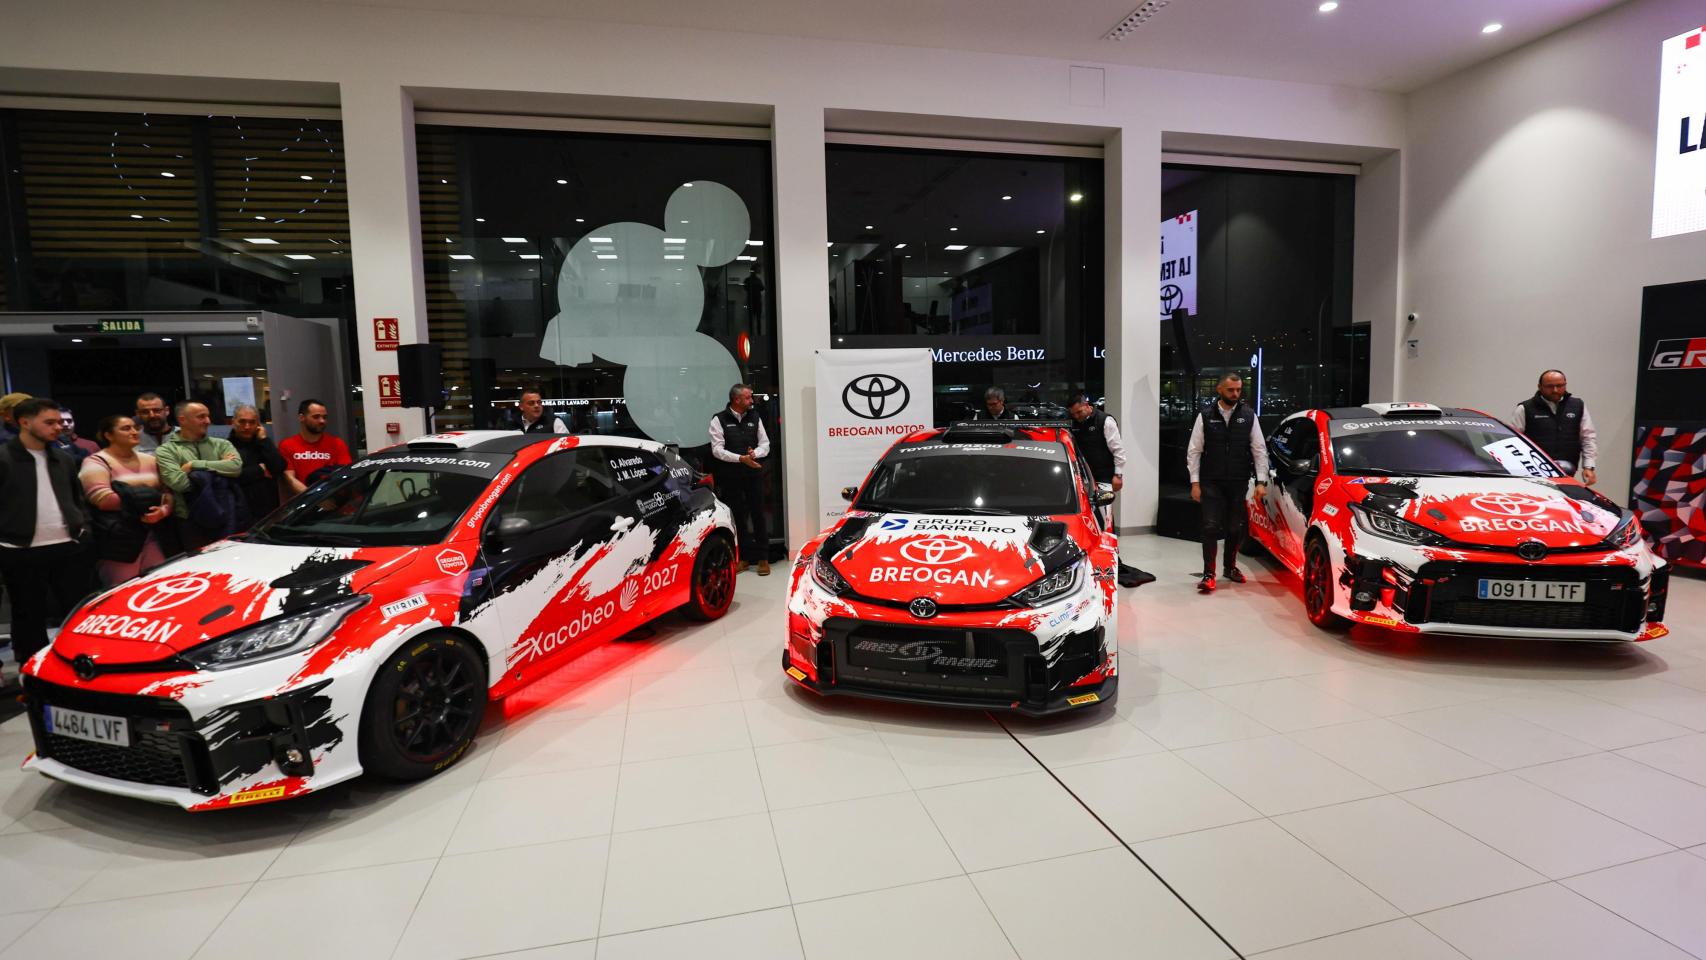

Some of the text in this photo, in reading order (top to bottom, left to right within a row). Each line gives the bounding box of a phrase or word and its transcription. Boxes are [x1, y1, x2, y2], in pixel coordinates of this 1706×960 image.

[102, 321, 141, 331] SALIDA
[931, 346, 1045, 362] Mercedes Benz
[828, 426, 883, 437] BREOGAN
[293, 451, 330, 460] adidas
[899, 444, 950, 453] TOYOTA
[466, 472, 512, 529] grupobreogan.com
[913, 524, 1016, 534] BARREIRO
[917, 518, 987, 526] GRUPO
[1459, 518, 1585, 534] BREOGAN
[442, 561, 465, 569] TOYOTA
[643, 563, 679, 595] 2027
[869, 566, 991, 588] BREOGAN
[1491, 582, 1581, 600] 0911 LTF
[72, 615, 182, 643] BREOGAN
[527, 600, 614, 662] Xacobeo
[55, 710, 123, 741] 4464 LVF
